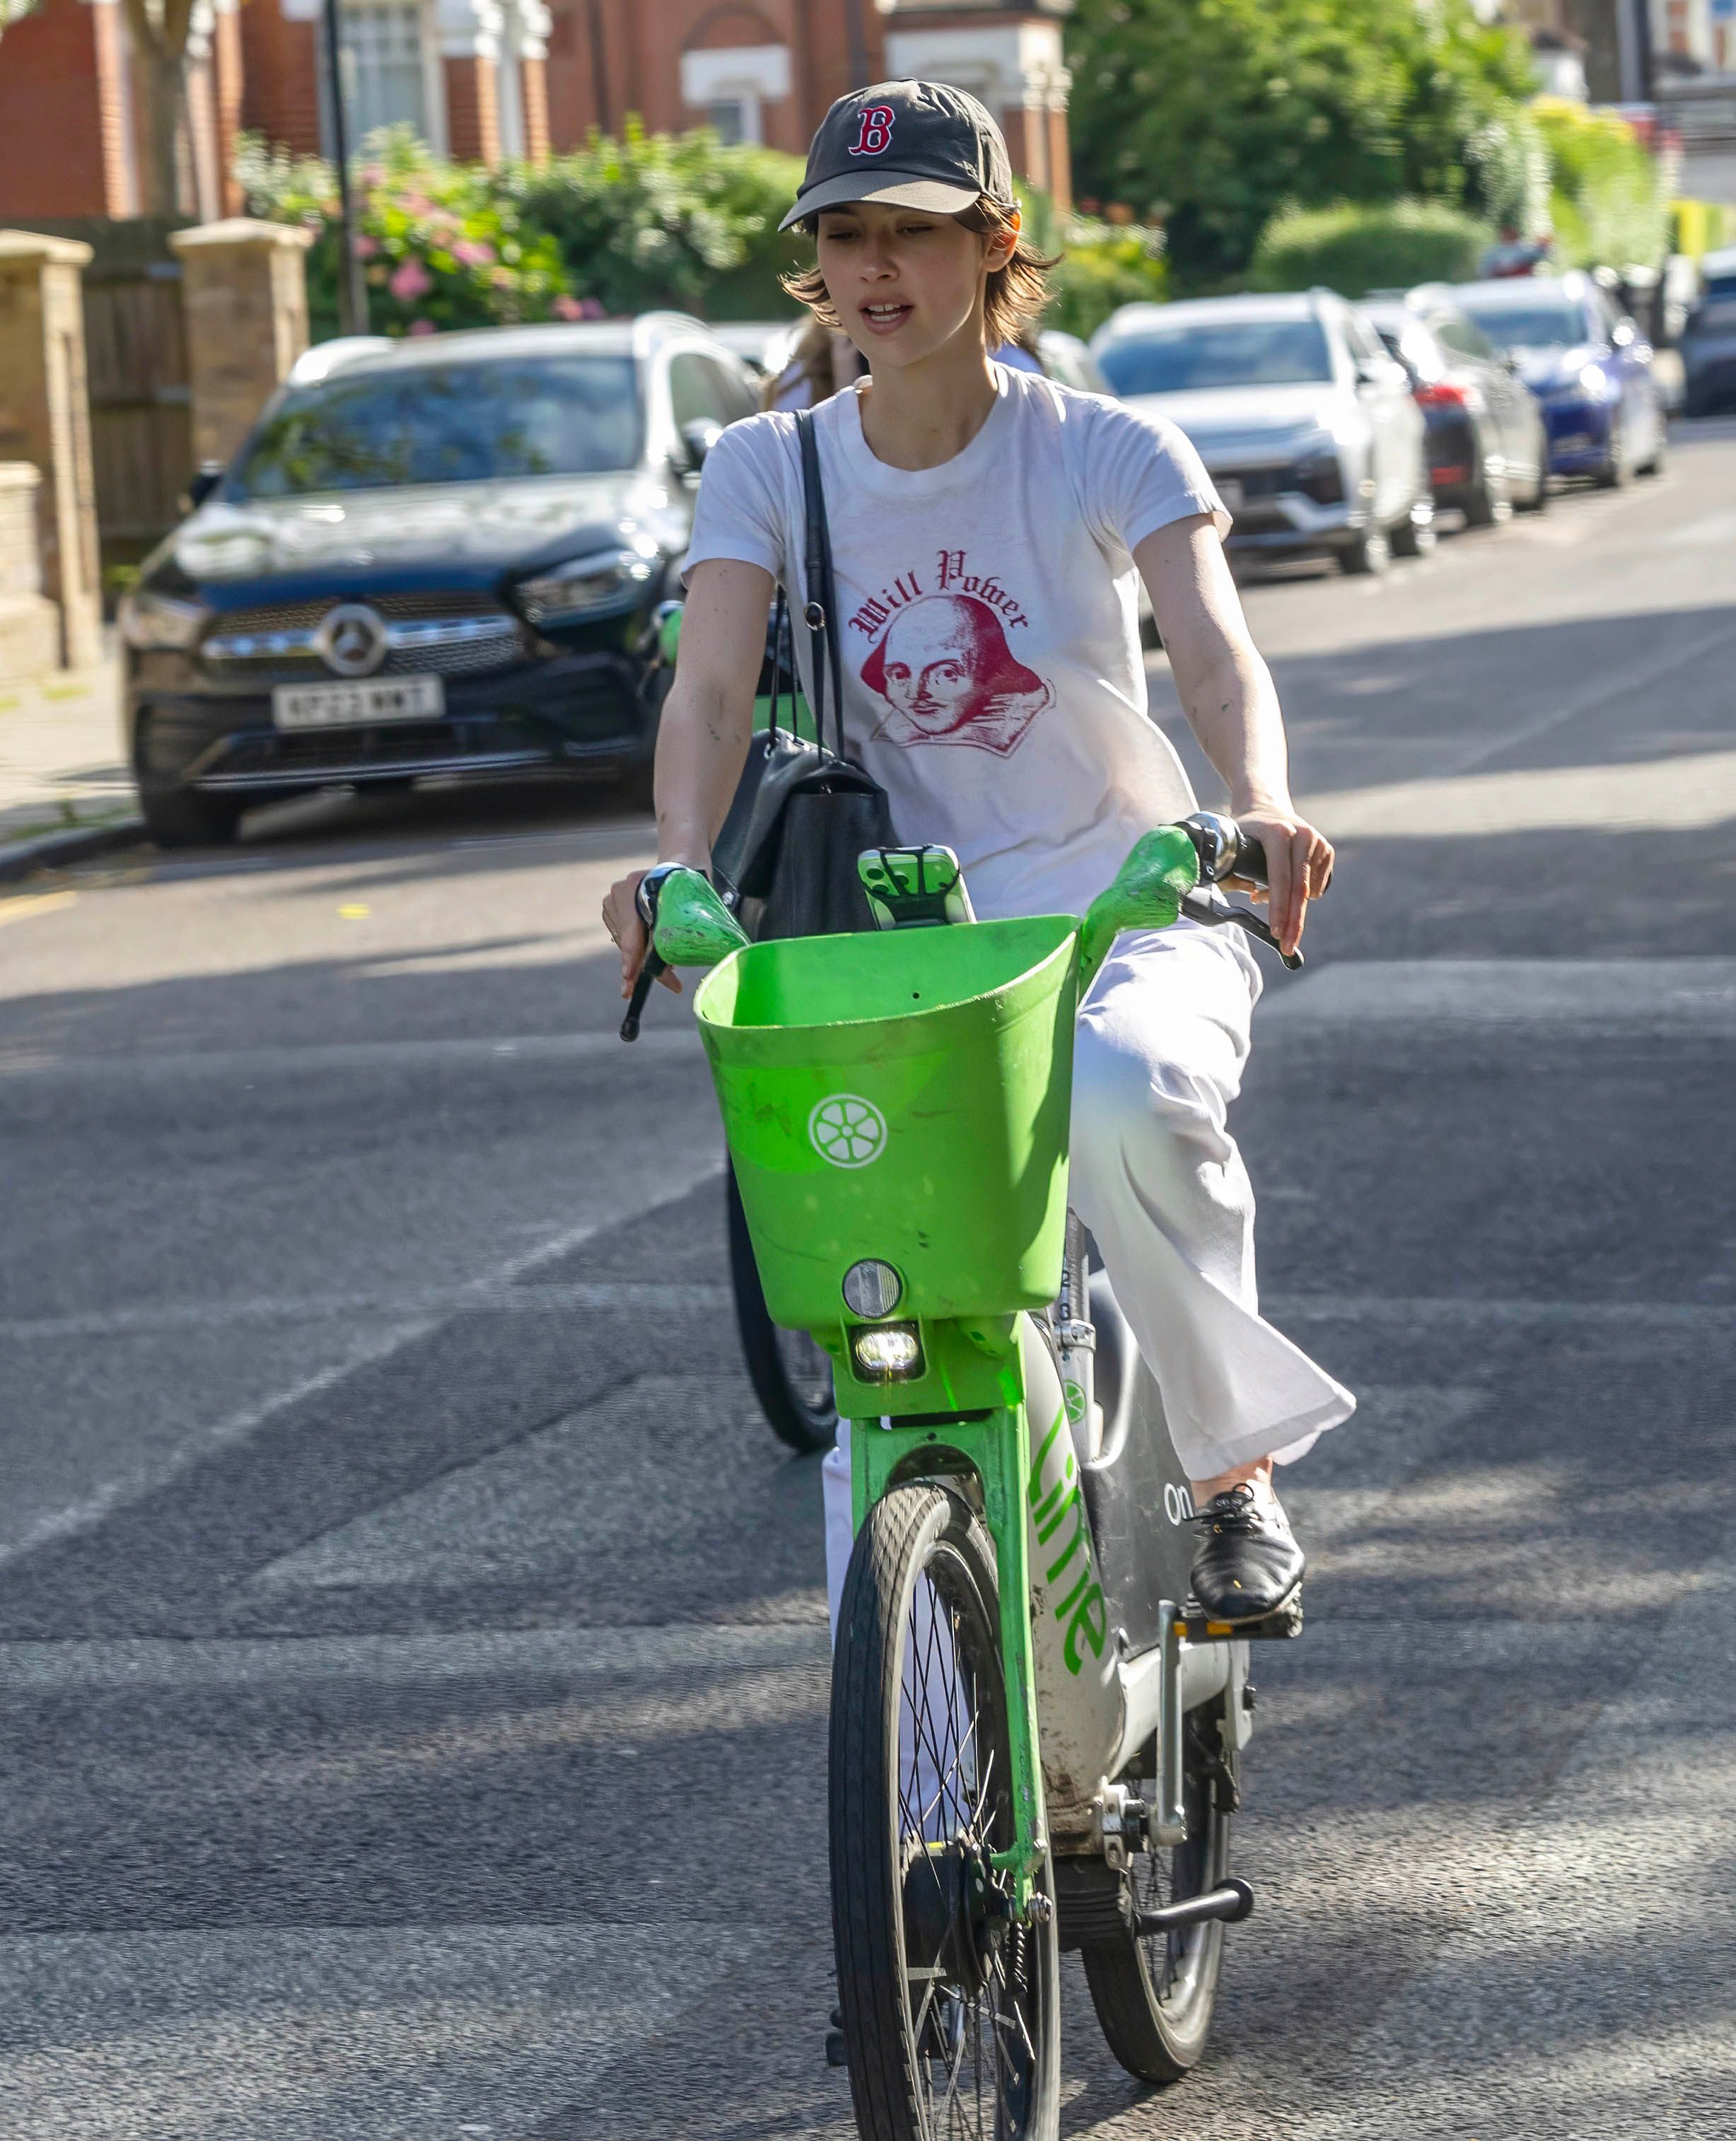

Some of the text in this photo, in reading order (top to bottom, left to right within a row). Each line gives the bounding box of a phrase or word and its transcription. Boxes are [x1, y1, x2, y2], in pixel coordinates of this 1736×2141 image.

[849, 105, 896, 156] B
[849, 549, 1029, 644] Will Power
[1028, 1402, 1107, 1676] Lime
